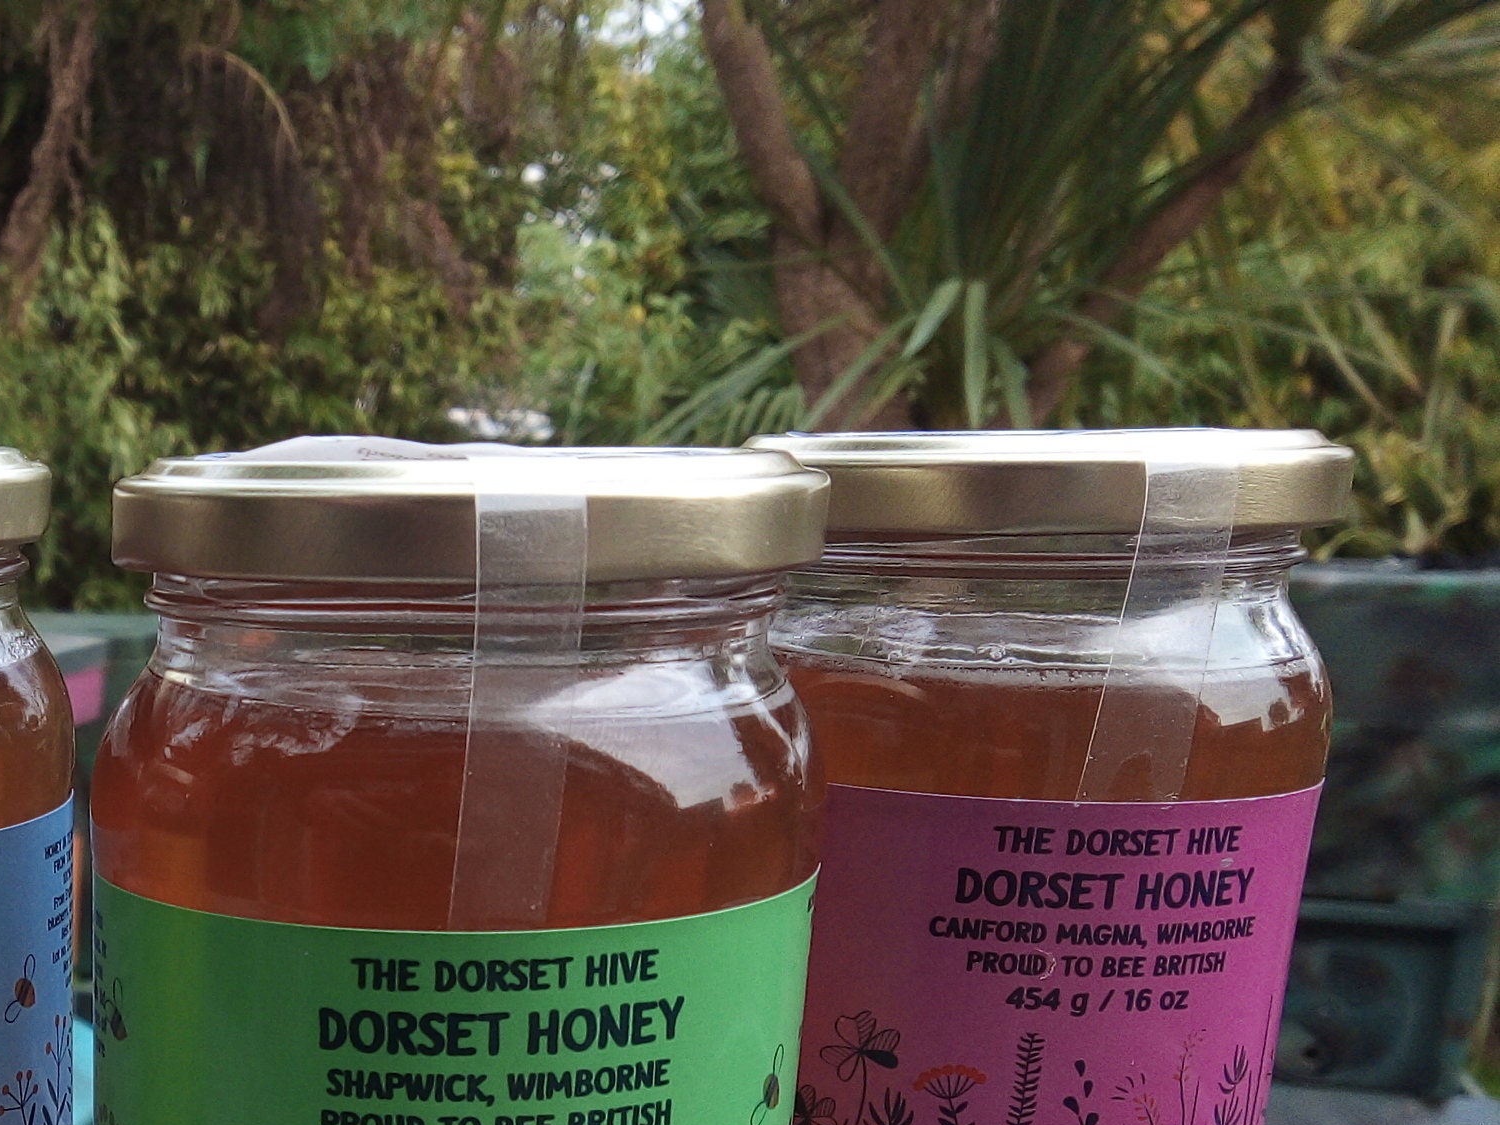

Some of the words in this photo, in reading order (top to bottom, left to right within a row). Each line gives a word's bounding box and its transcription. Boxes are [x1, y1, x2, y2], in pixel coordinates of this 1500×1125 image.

[993, 826, 1055, 855] THE
[1066, 828, 1180, 856] DORSET
[1187, 826, 1242, 855] HIVE
[955, 867, 1124, 911] DORSET
[1135, 867, 1254, 911] HONEY
[929, 915, 1047, 945] CANFORD
[1056, 923, 1147, 949] MAGNA,
[1157, 916, 1255, 945] WIMBORNE
[350, 957, 420, 993] THE
[435, 955, 574, 993] DORSET
[585, 949, 659, 988] HIVE
[966, 951, 1047, 976] PROUD
[1061, 955, 1093, 978] TO
[1101, 955, 1146, 978] BEE
[1153, 951, 1226, 977] BRITISH
[1006, 987, 1060, 1011] 454
[1071, 993, 1089, 1018] g
[1099, 989, 1114, 1012] /
[1125, 988, 1152, 1012] 16
[1160, 991, 1189, 1011] oz
[319, 1006, 510, 1057] DORSET
[527, 996, 684, 1056] HONEY
[326, 1067, 495, 1108] SHAPWICK,
[507, 1059, 670, 1102] WIMBORNE
